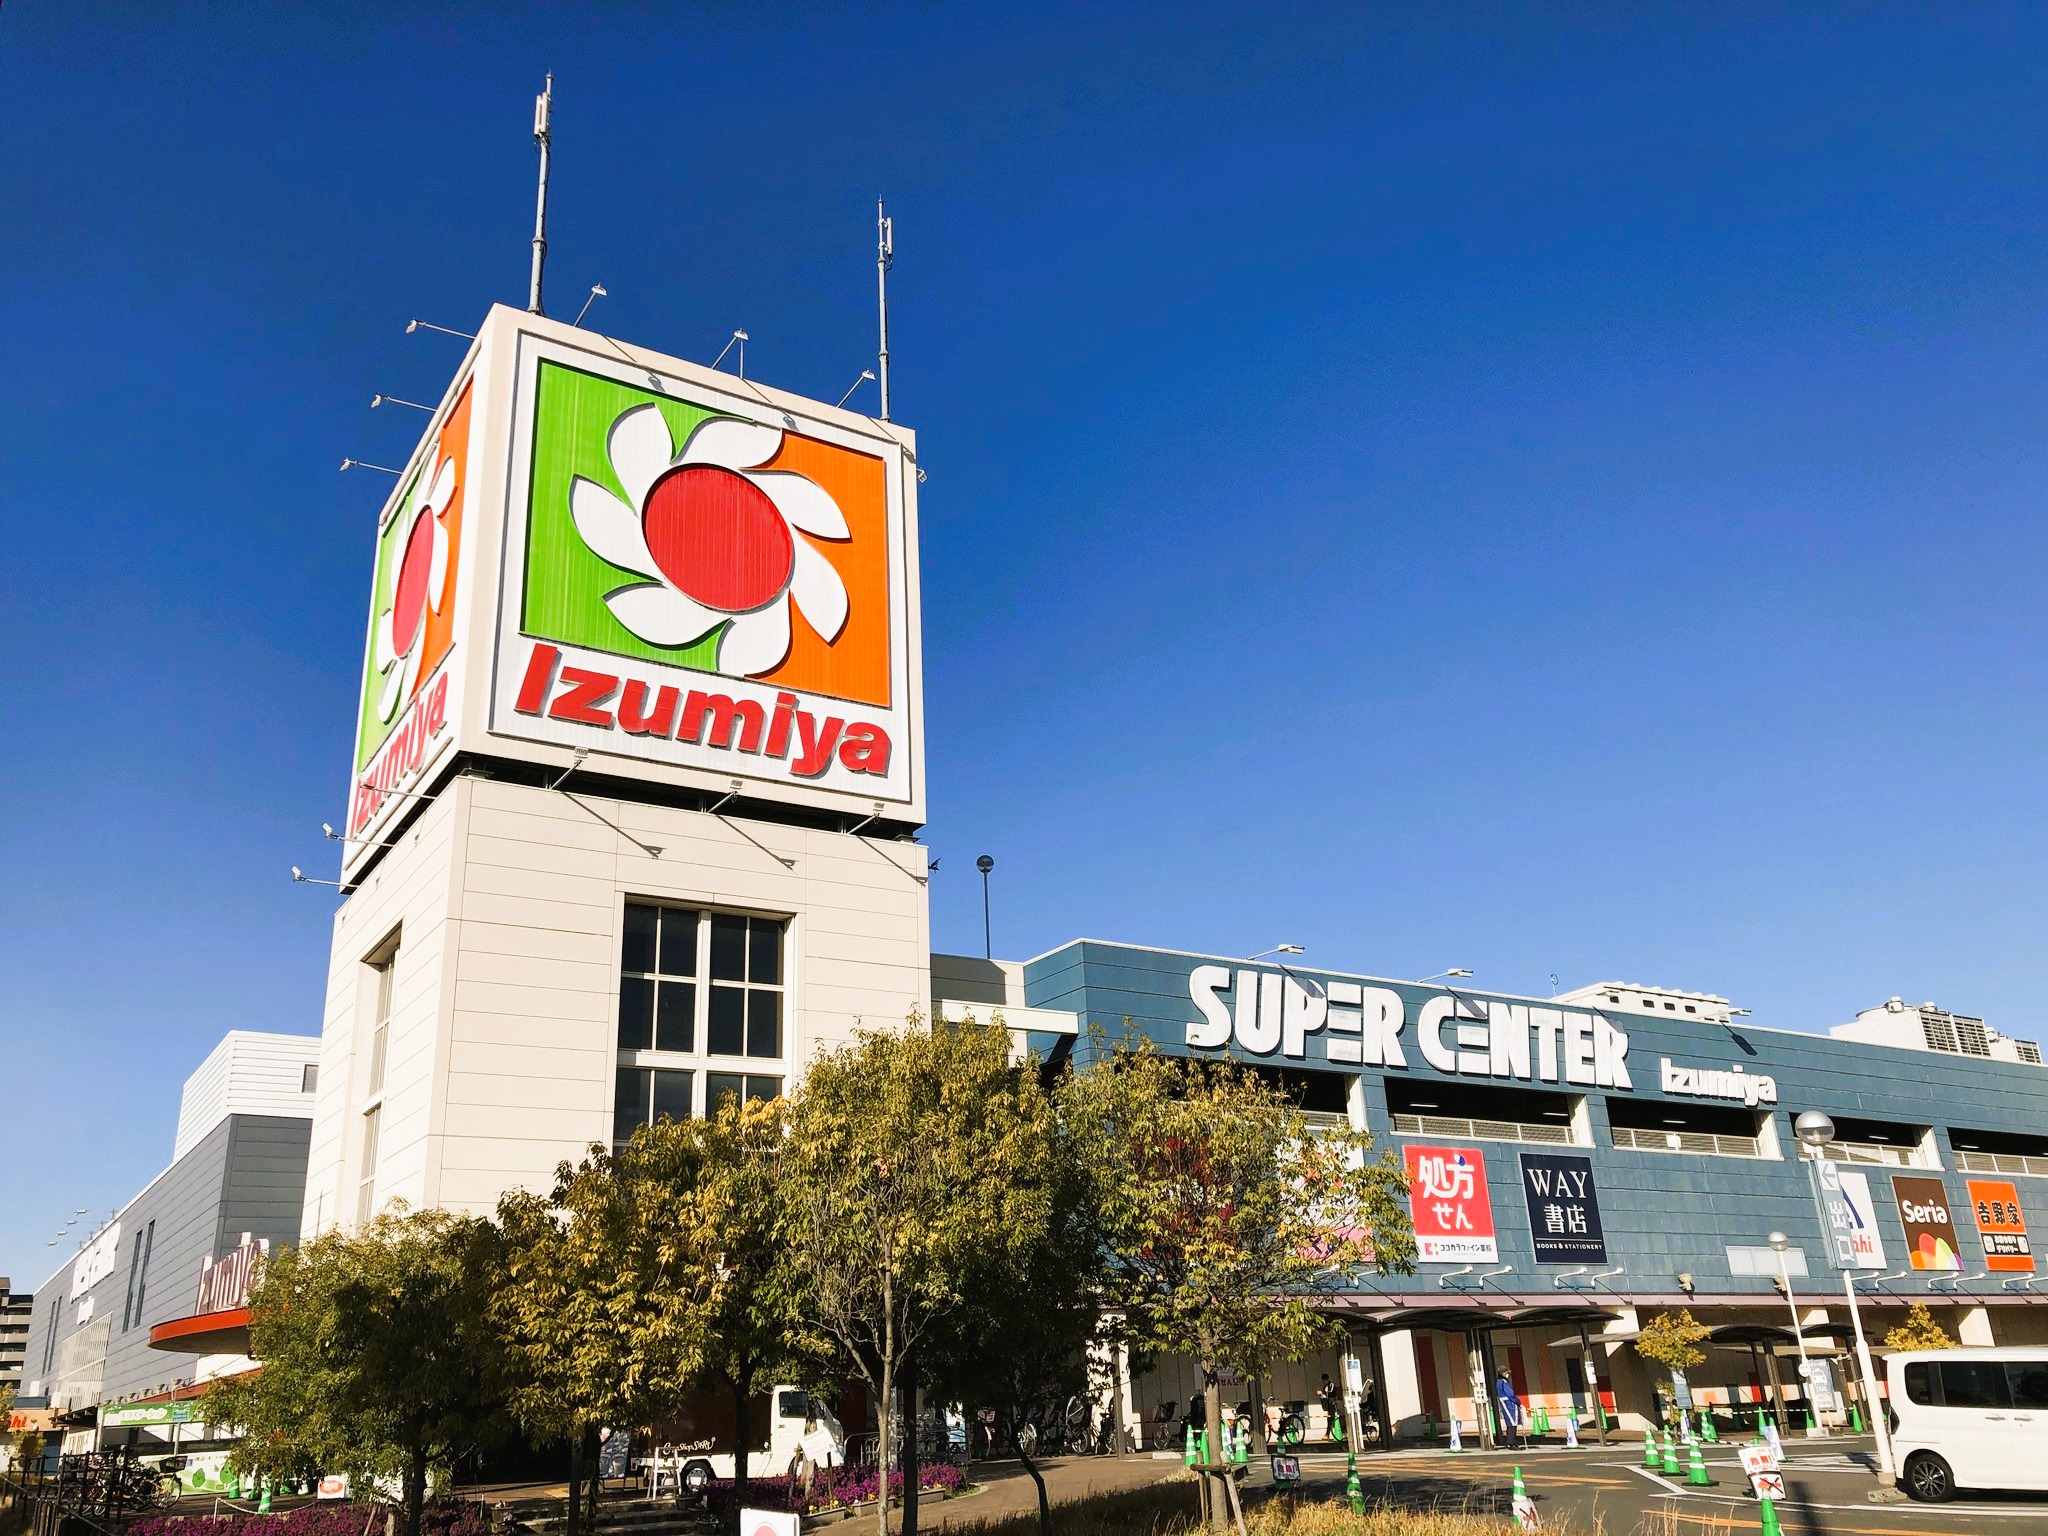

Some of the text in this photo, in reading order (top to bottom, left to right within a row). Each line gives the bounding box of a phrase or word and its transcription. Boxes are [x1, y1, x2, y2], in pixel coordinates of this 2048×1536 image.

[514, 643, 890, 778] Izumiya
[1186, 964, 1633, 1089] SUPER CENTER
[1661, 1058, 1777, 1106] Izumiya
[1417, 1154, 1475, 1199] 処方
[1527, 1168, 1588, 1198] WAY
[1431, 1202, 1474, 1229] せん
[1543, 1204, 1588, 1234] 書店
[1902, 1199, 1948, 1224] Seria
[1978, 1201, 2021, 1225] 吉野家
[1828, 1201, 1855, 1262] 出口
